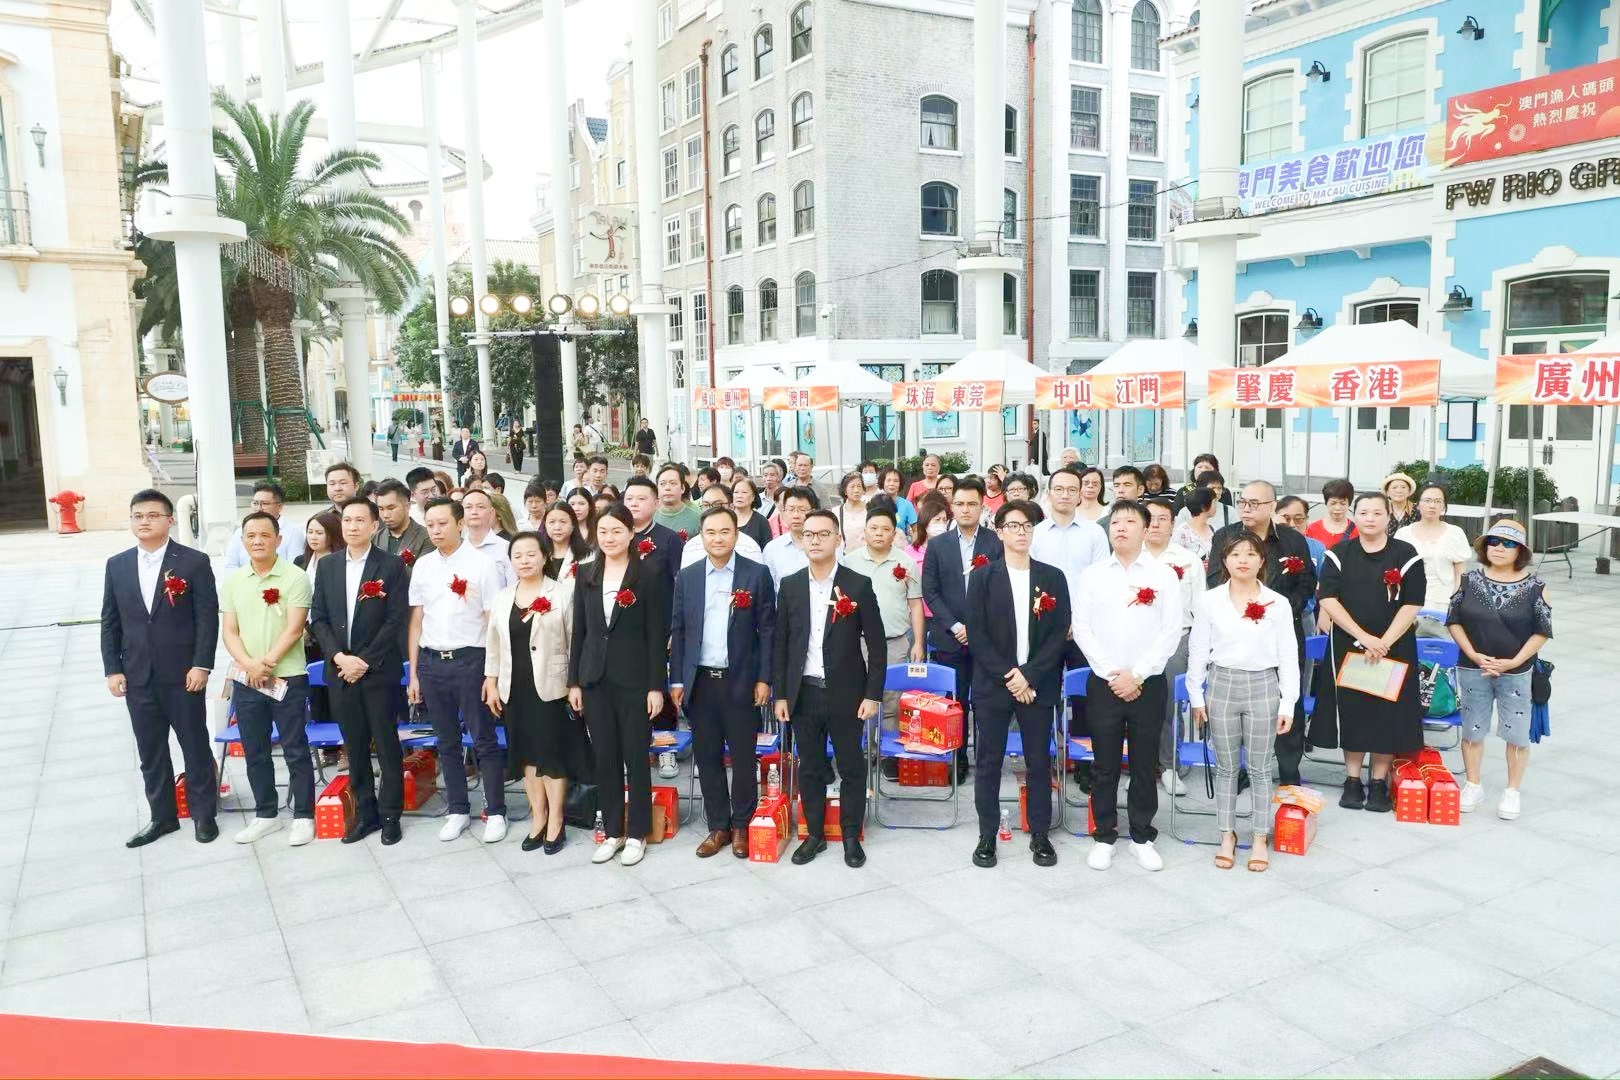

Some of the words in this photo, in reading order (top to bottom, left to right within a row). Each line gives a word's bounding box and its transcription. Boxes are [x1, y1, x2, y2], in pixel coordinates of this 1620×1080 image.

[1517, 77, 1616, 111] 澳門漁人碼頭
[1532, 102, 1597, 128] 熱烈慶祝
[1254, 196, 1294, 209] WELCOME
[1298, 193, 1310, 202] TO
[1312, 186, 1347, 200] MACAU
[1349, 178, 1388, 193] CUISINE
[1446, 178, 1496, 210] FW
[1502, 168, 1563, 202] RIO
[1054, 380, 1092, 406] 中山
[1116, 378, 1160, 405] 江門
[1236, 373, 1295, 403] 肇慶
[1331, 367, 1399, 401] 香港
[1534, 360, 1620, 398] 廣州
[788, 390, 809, 407] 澳門
[906, 386, 935, 407] 珠海
[951, 385, 985, 407] 東莞
